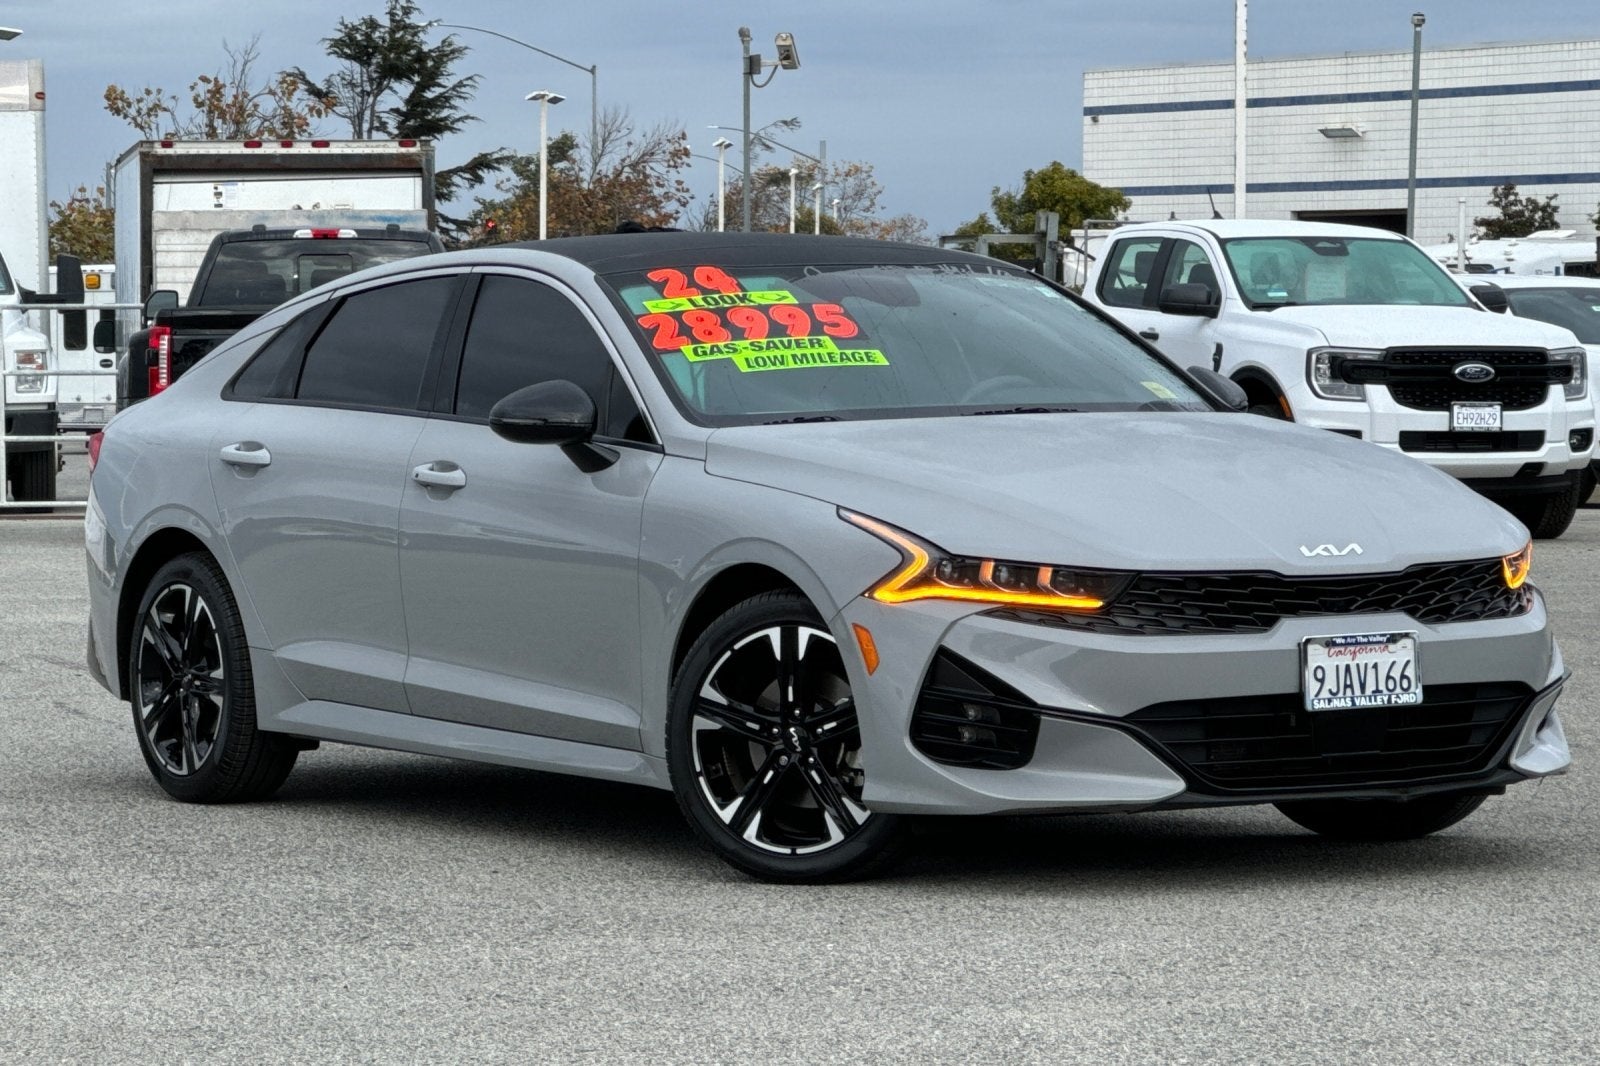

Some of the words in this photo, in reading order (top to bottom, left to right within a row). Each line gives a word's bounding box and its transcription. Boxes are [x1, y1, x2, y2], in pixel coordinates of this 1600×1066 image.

[687, 292, 755, 308] LOOK
[637, 304, 859, 350] 28995
[792, 350, 879, 366] MILEAGE
[1456, 412, 1498, 426] EH92H29
[1356, 635, 1369, 643] The
[1327, 644, 1396, 661] California
[1313, 660, 1412, 698] 9JAV166
[1354, 694, 1389, 706] VALLEY
